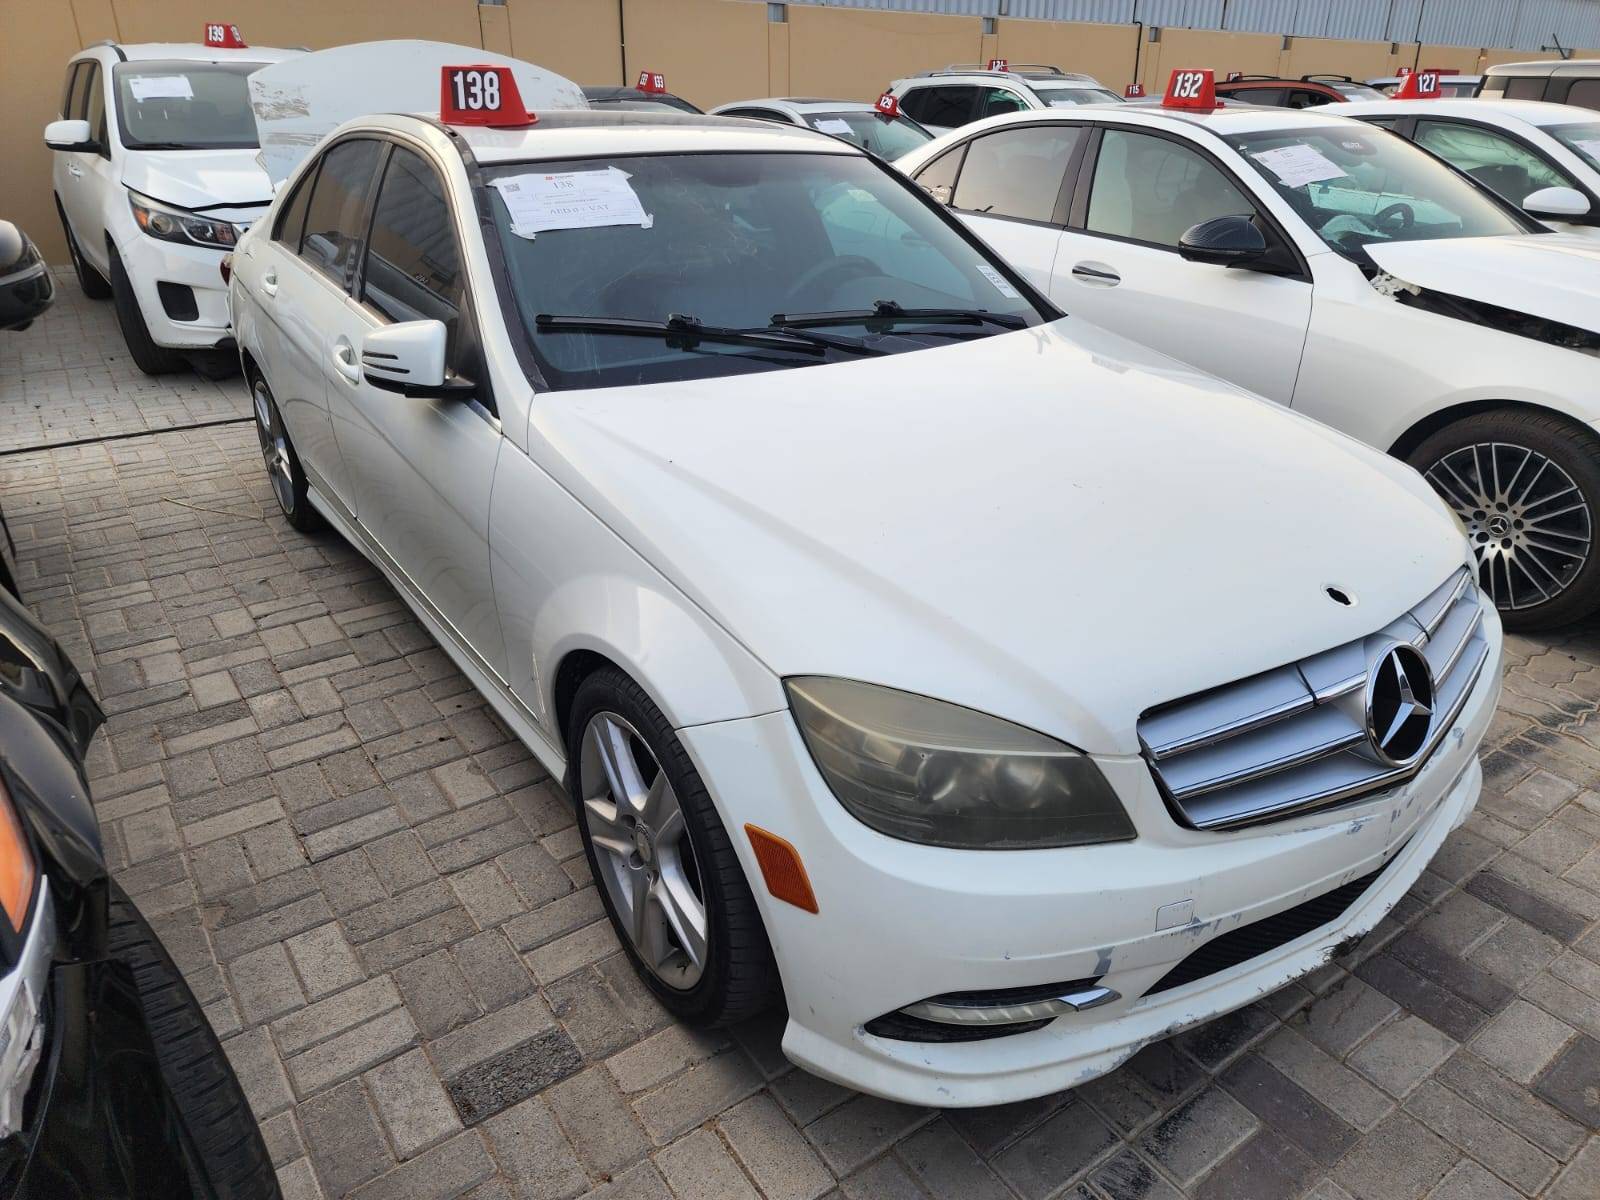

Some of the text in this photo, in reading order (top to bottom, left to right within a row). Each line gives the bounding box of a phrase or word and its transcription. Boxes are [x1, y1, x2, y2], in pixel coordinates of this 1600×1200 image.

[208, 25, 224, 42] 139
[453, 71, 500, 110] 138
[1173, 72, 1204, 98] 132
[1418, 73, 1436, 93] 127
[880, 96, 893, 109] 129
[552, 180, 574, 190] 138
